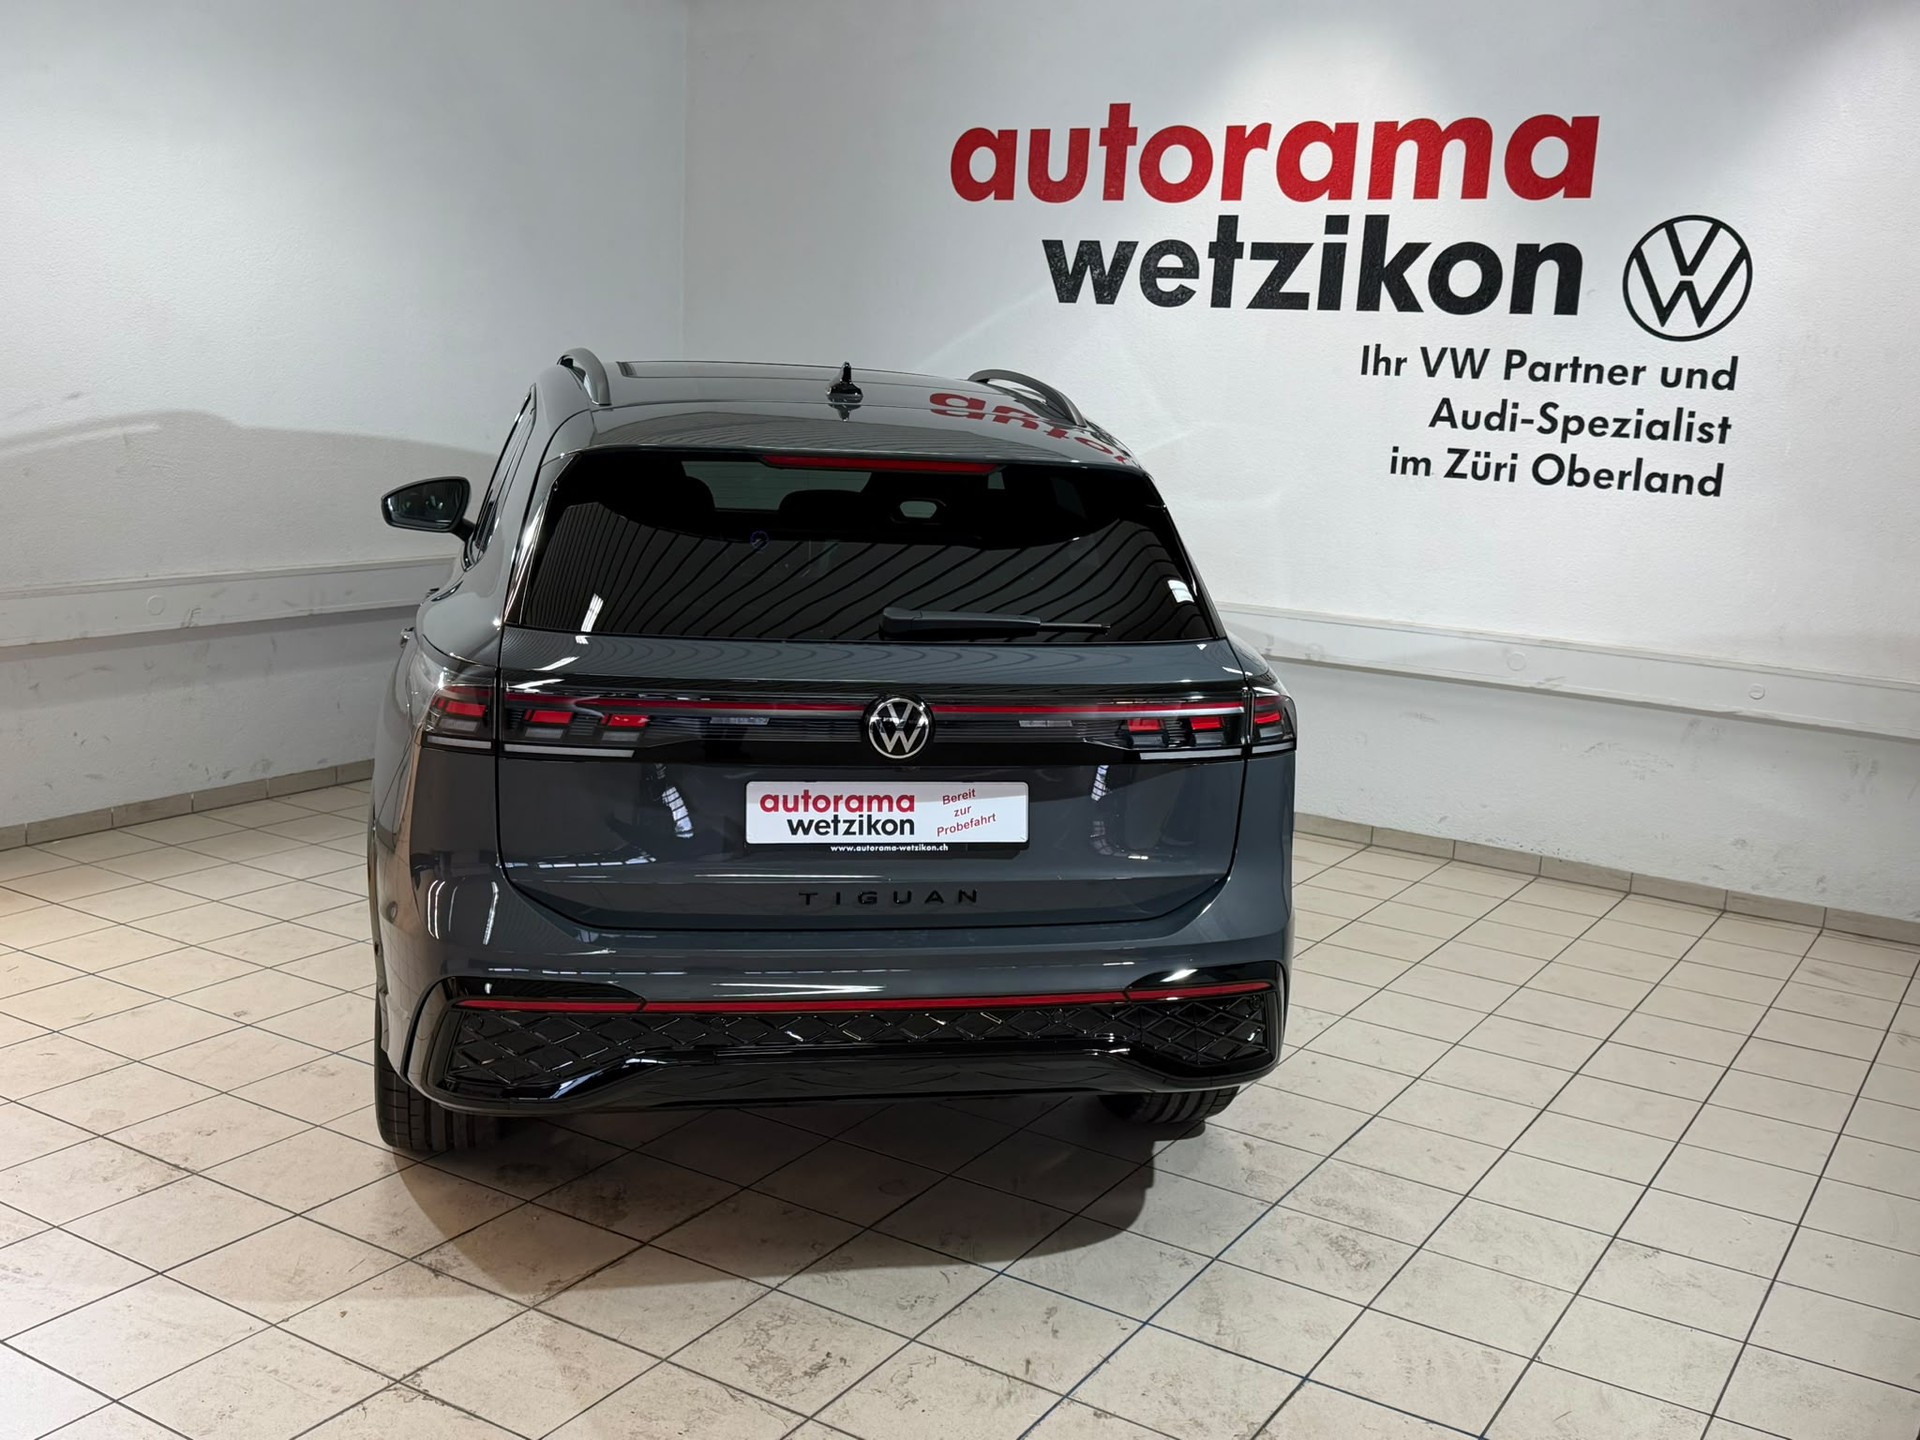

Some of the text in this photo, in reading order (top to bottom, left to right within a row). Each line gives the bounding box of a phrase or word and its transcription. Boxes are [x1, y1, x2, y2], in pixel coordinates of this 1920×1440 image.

[950, 102, 1600, 204] autorama
[1041, 214, 1583, 316] wetzikon
[1361, 344, 1739, 391] Ihr VW Partner und
[1428, 397, 1732, 445] Audi-Spezialist
[1390, 446, 1724, 497] im Züri Oberland
[759, 789, 915, 813] autorama
[942, 788, 976, 806] Bereit
[953, 804, 972, 818] zur
[786, 814, 915, 836] wetzikon
[937, 812, 997, 837] Probefahrt
[830, 843, 949, 853] www.autorama-wetzikon.ch
[798, 889, 978, 906] TIGUAN
